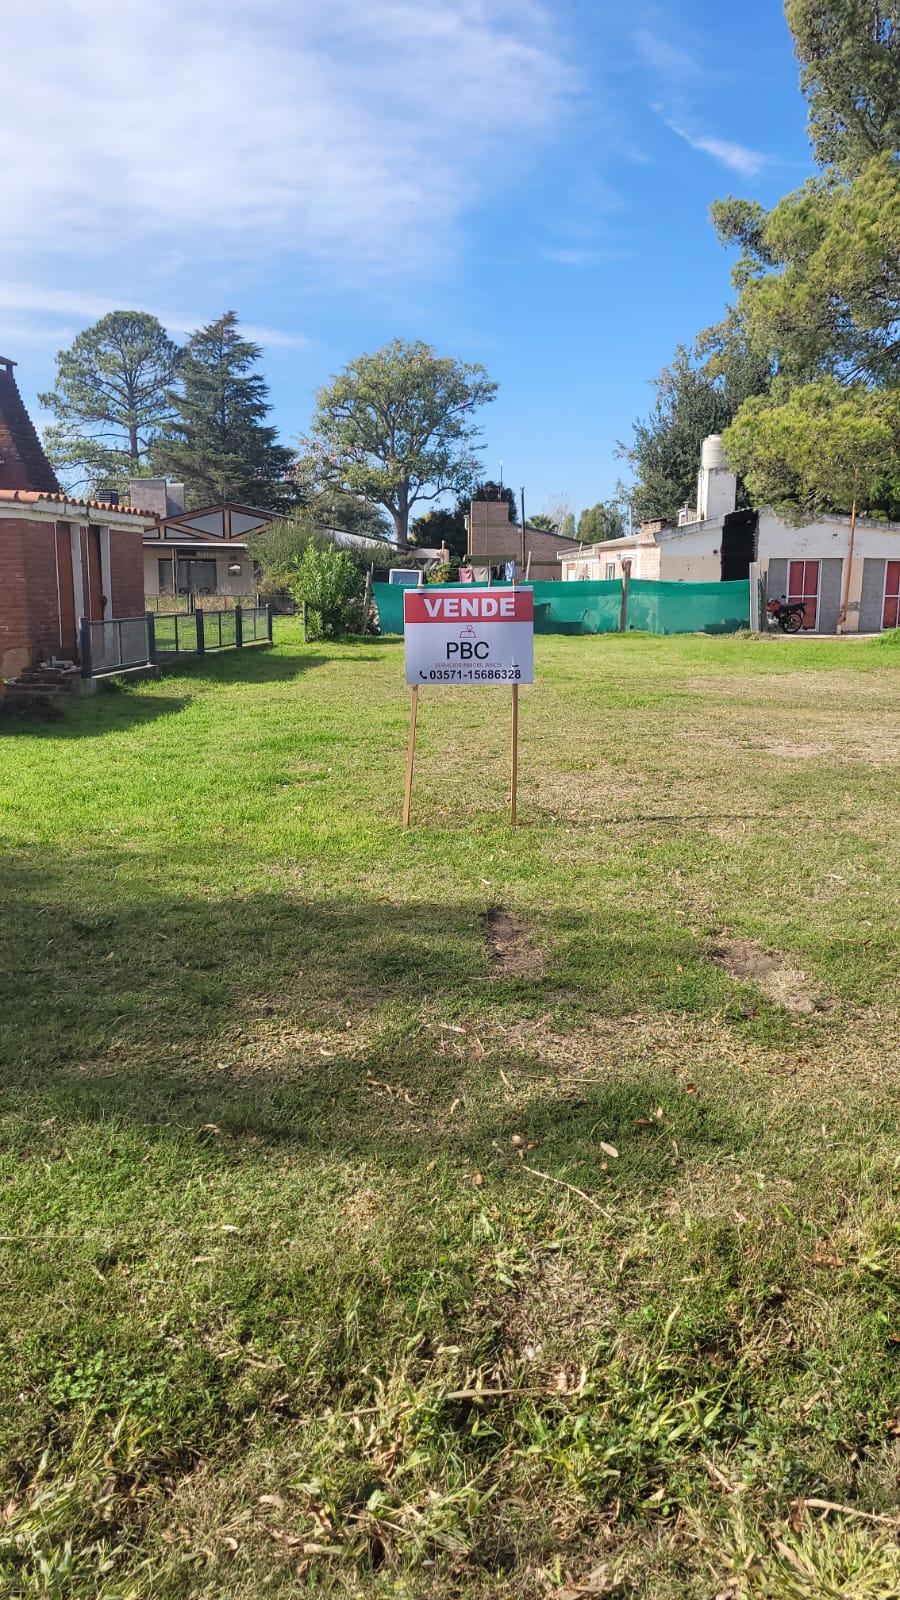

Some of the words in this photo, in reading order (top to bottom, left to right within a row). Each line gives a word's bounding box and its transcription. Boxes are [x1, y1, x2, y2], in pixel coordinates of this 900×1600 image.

[424, 598, 516, 617] VENDE
[446, 641, 490, 660] PBC
[429, 669, 521, 680] 03571-15686328
